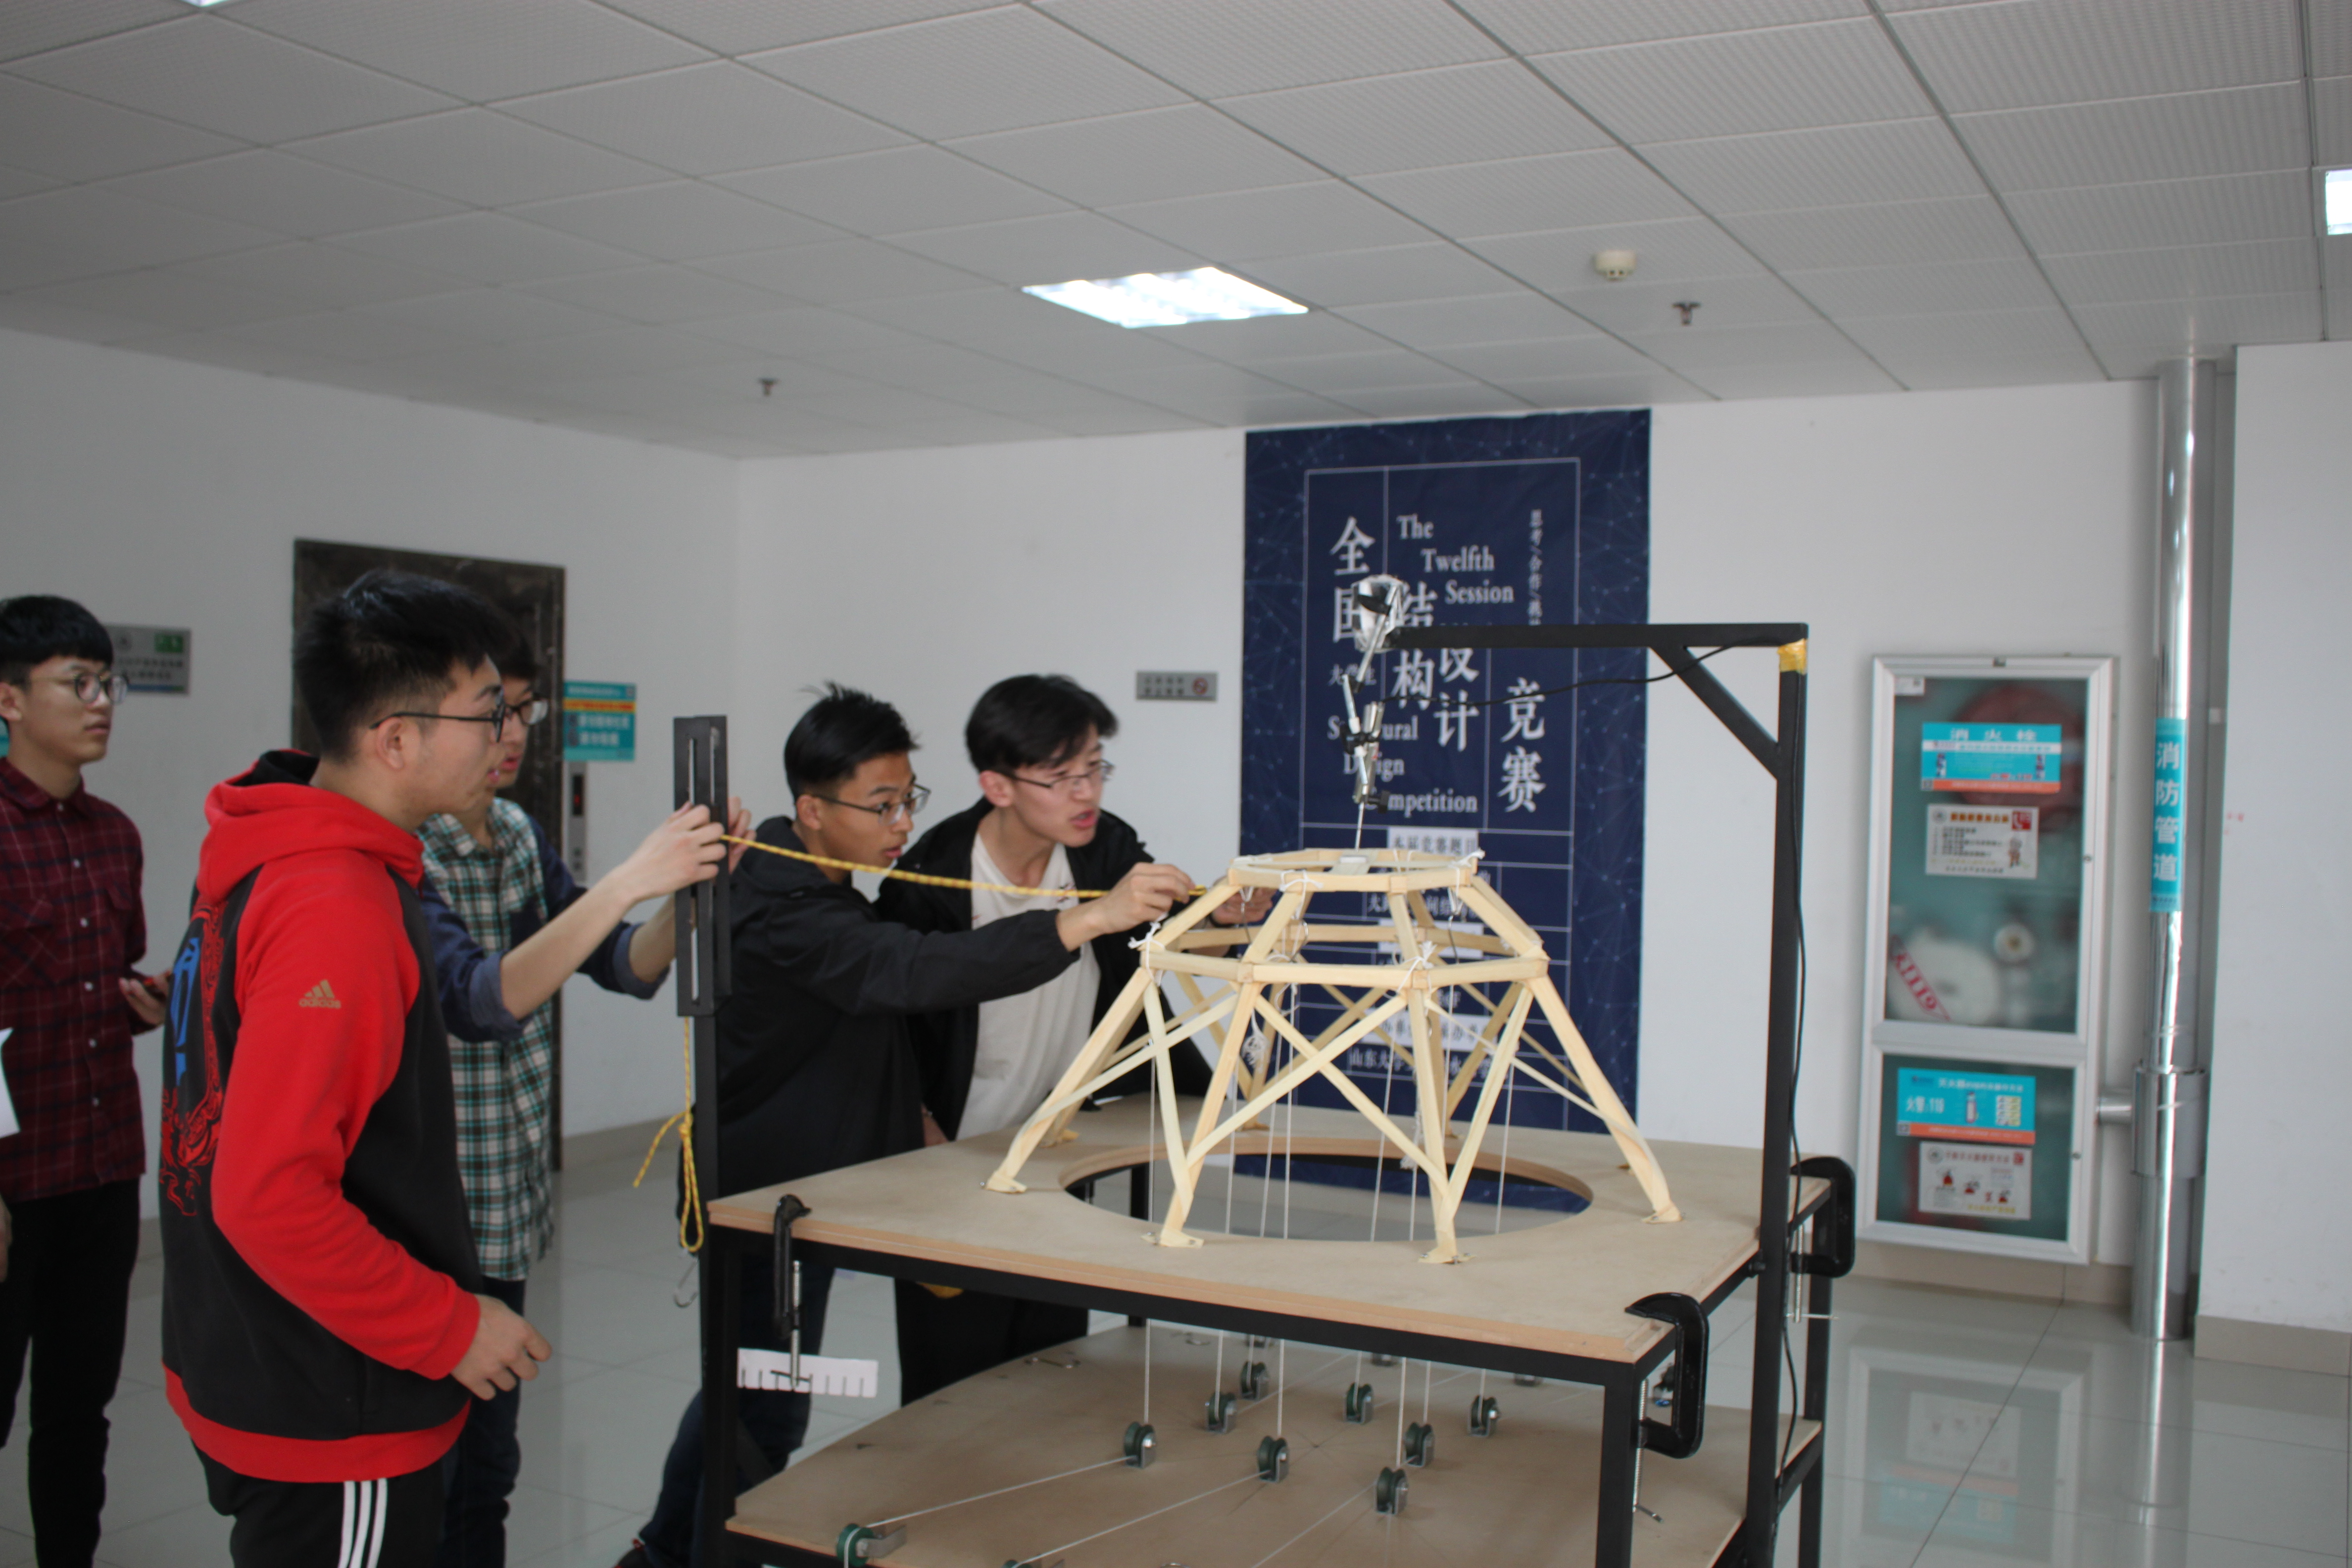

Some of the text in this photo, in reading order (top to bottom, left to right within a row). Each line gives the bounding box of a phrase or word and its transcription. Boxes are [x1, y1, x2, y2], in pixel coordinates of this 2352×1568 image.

[1396, 513, 1434, 540] The
[1420, 544, 1495, 573] Twelfth
[1444, 579, 1515, 604] Session
[1327, 715, 1419, 741] Sural
[1497, 677, 1546, 813] 竞赛
[1343, 750, 1405, 782] Dign
[2153, 741, 2181, 882] 消防管道
